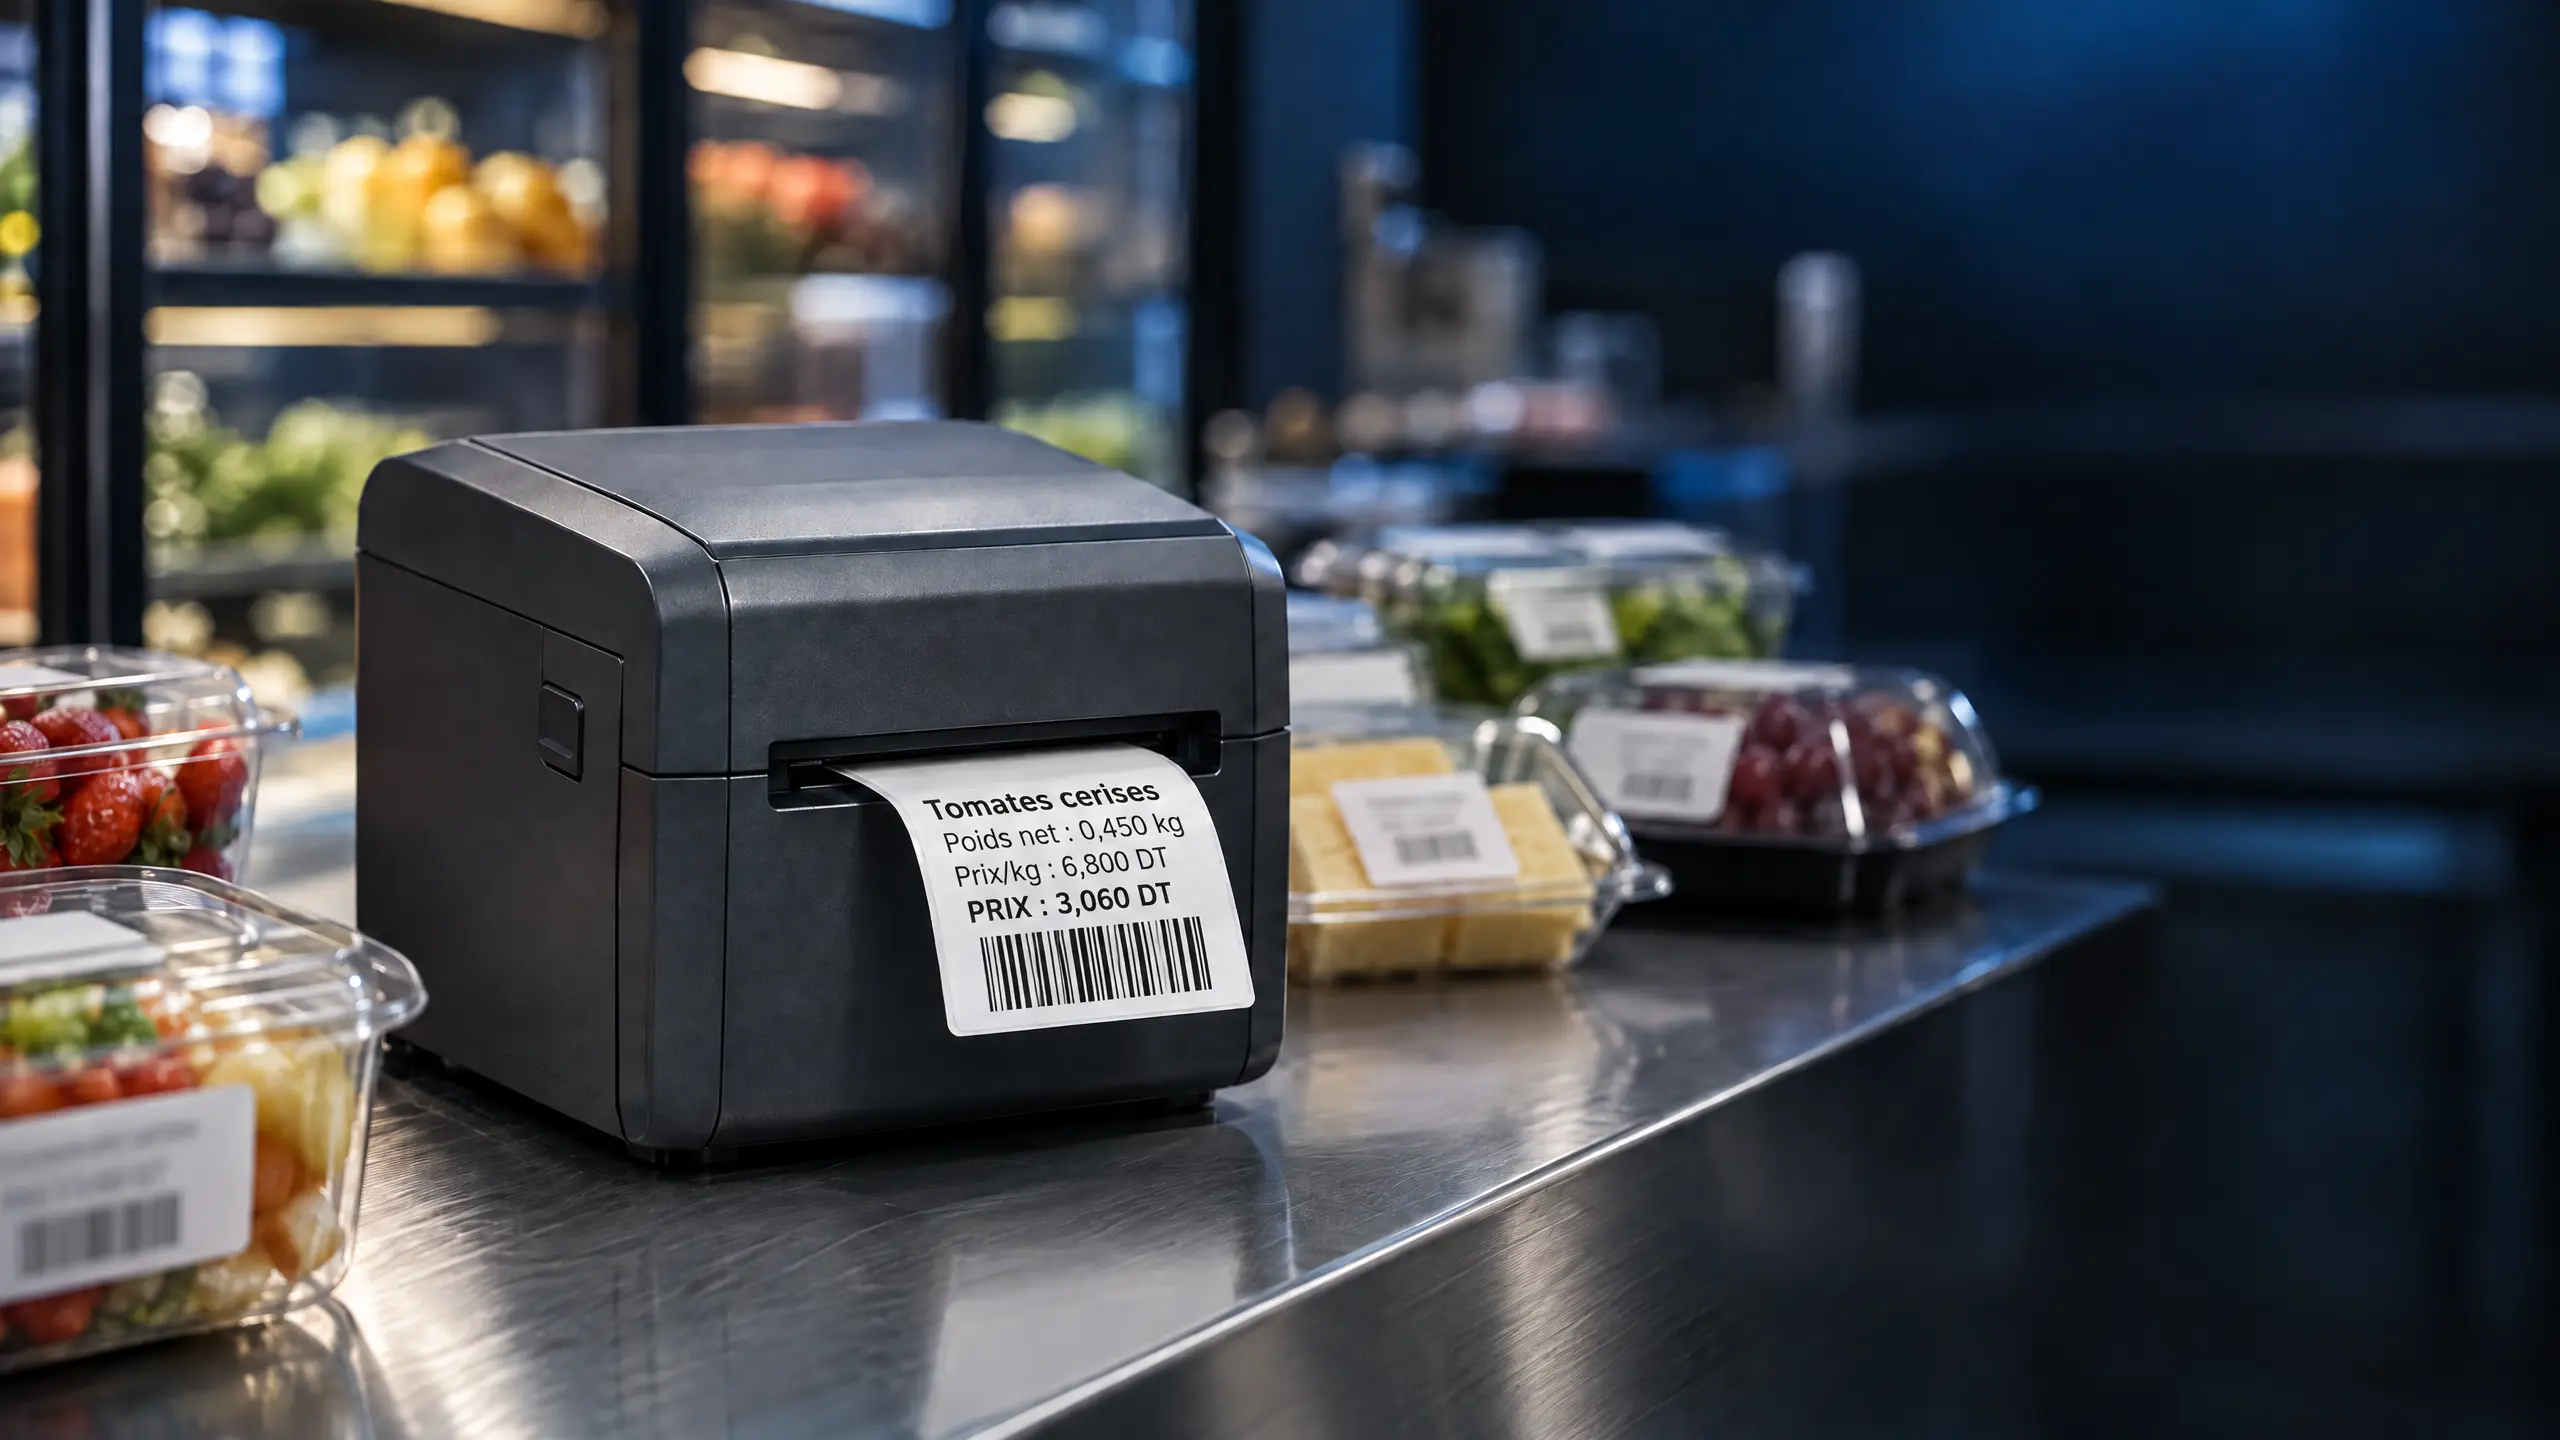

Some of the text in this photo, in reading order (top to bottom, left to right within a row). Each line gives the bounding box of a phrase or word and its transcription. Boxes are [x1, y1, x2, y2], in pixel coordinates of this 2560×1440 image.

[921, 782, 1160, 821] Tomates cerises
[942, 813, 1185, 854] Poids net : 0,450 kg
[954, 846, 1167, 888] Prix/kg : 6,800 DT
[967, 881, 1171, 924] PRIX : 3,060 DT
